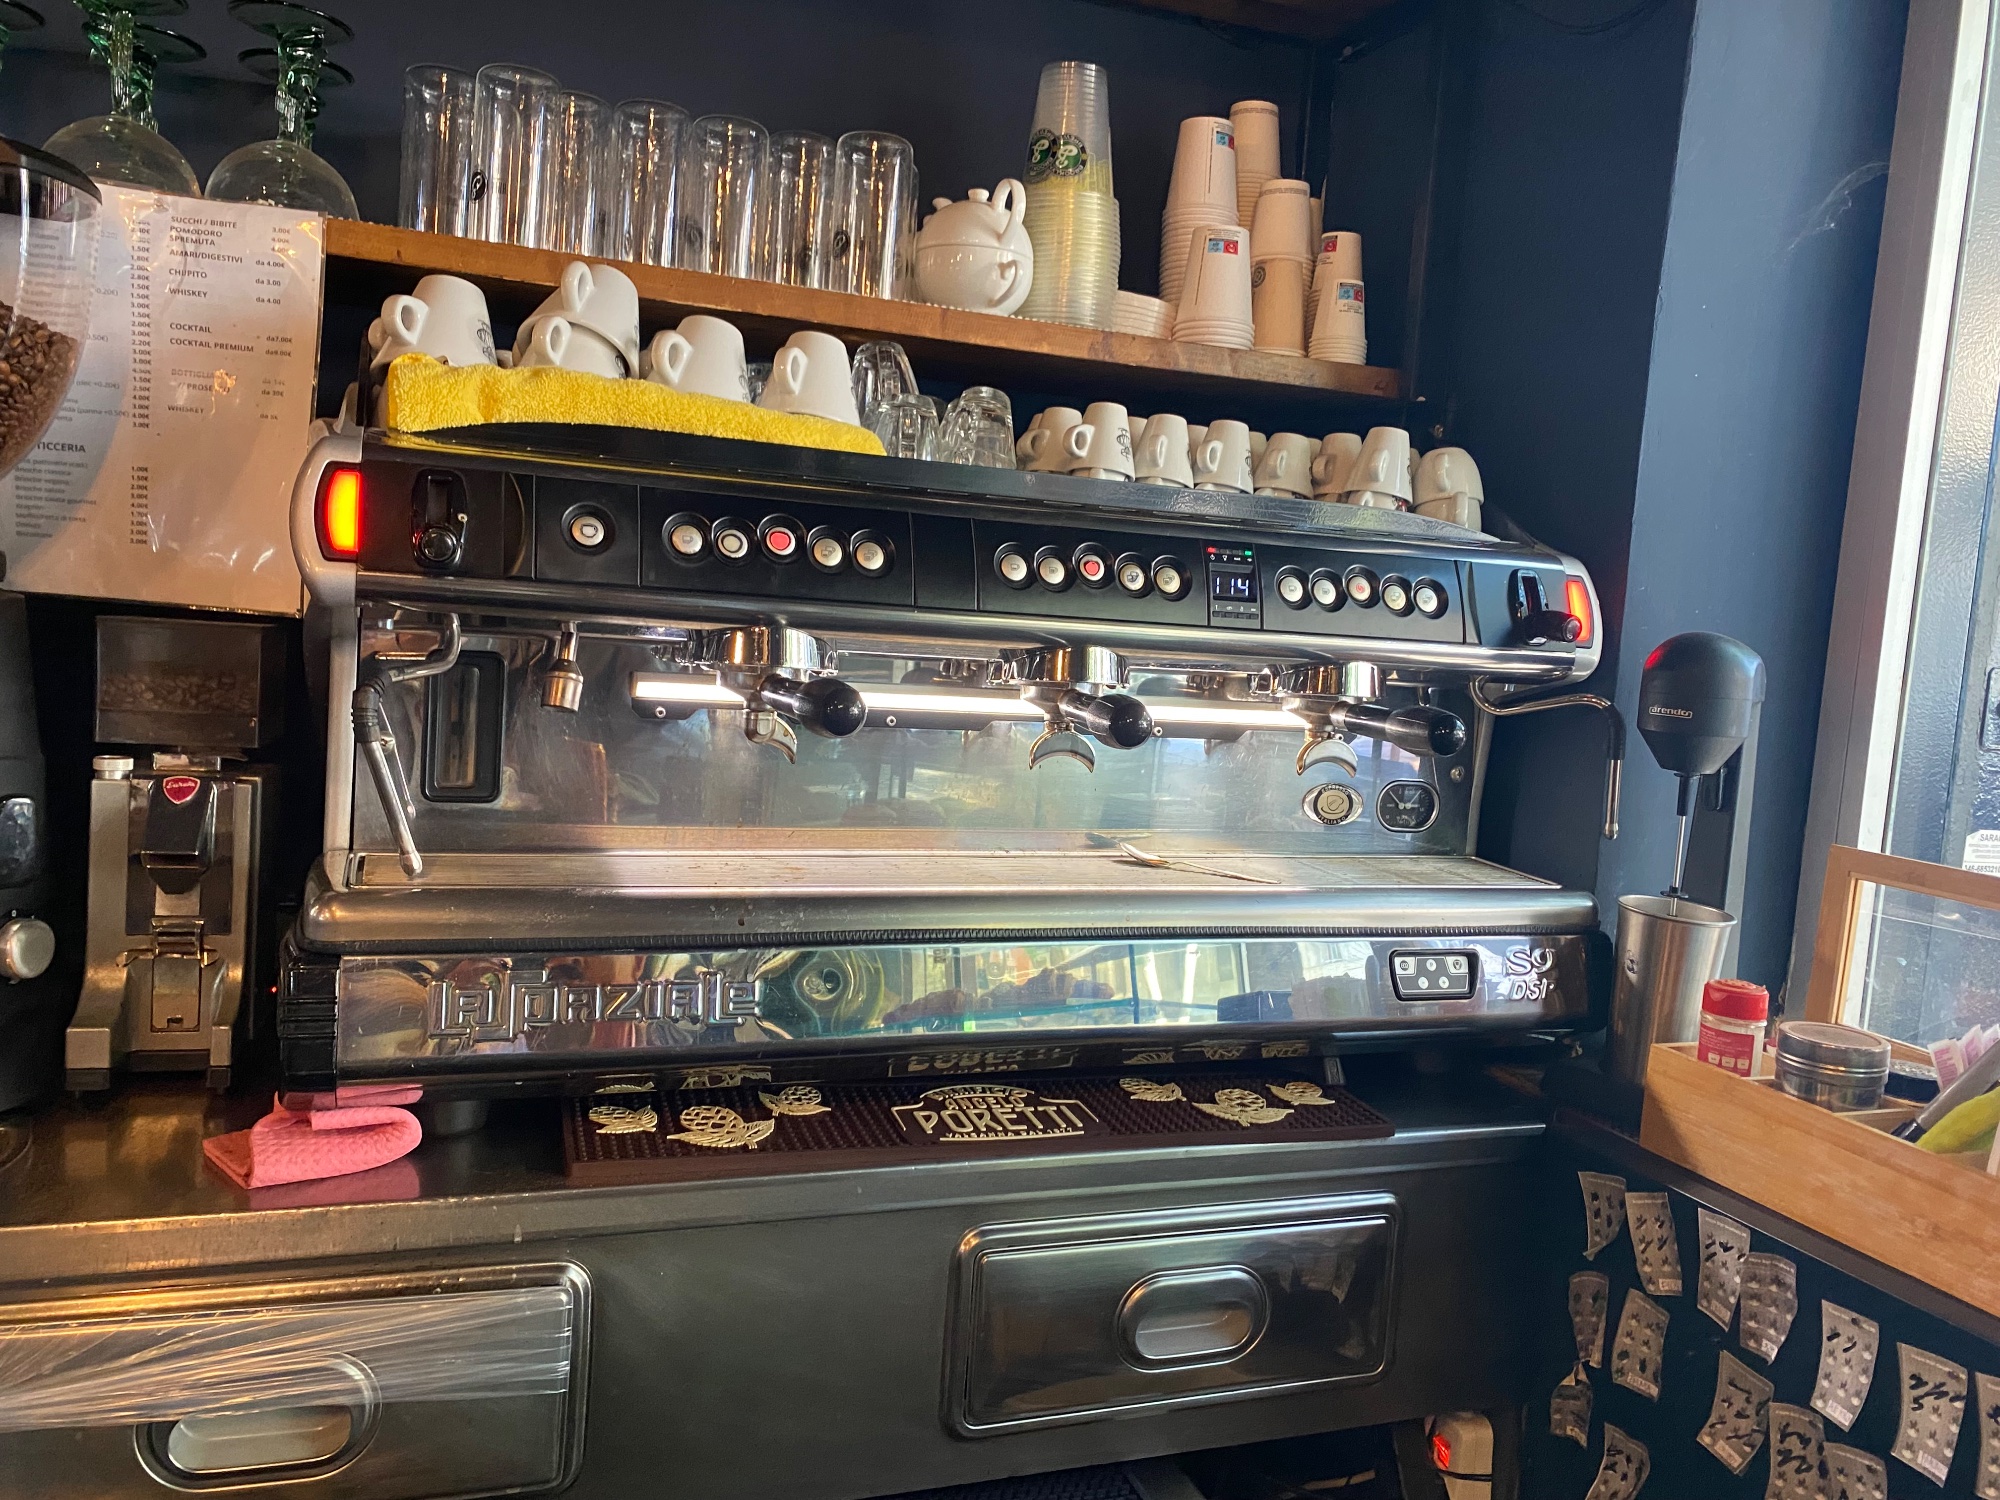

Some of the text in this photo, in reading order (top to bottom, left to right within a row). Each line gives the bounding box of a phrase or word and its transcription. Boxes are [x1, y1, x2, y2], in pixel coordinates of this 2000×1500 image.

[171, 216, 202, 225] SUCCHI
[210, 219, 237, 228] BIBITE
[169, 225, 222, 237] POMODORO
[169, 235, 215, 246] SPREMUTA
[169, 249, 243, 263] AMARI/DIGESTIVI
[169, 268, 207, 279] CHUPITO
[169, 287, 208, 298] WHISKEY
[170, 322, 212, 333] COCKTAIL
[170, 338, 254, 352] COCKTAIL PREMIUM
[1215, 576, 1249, 596] 114
[944, 1094, 1025, 1110] ANGELO
[913, 1105, 1084, 1134] PORETTI
